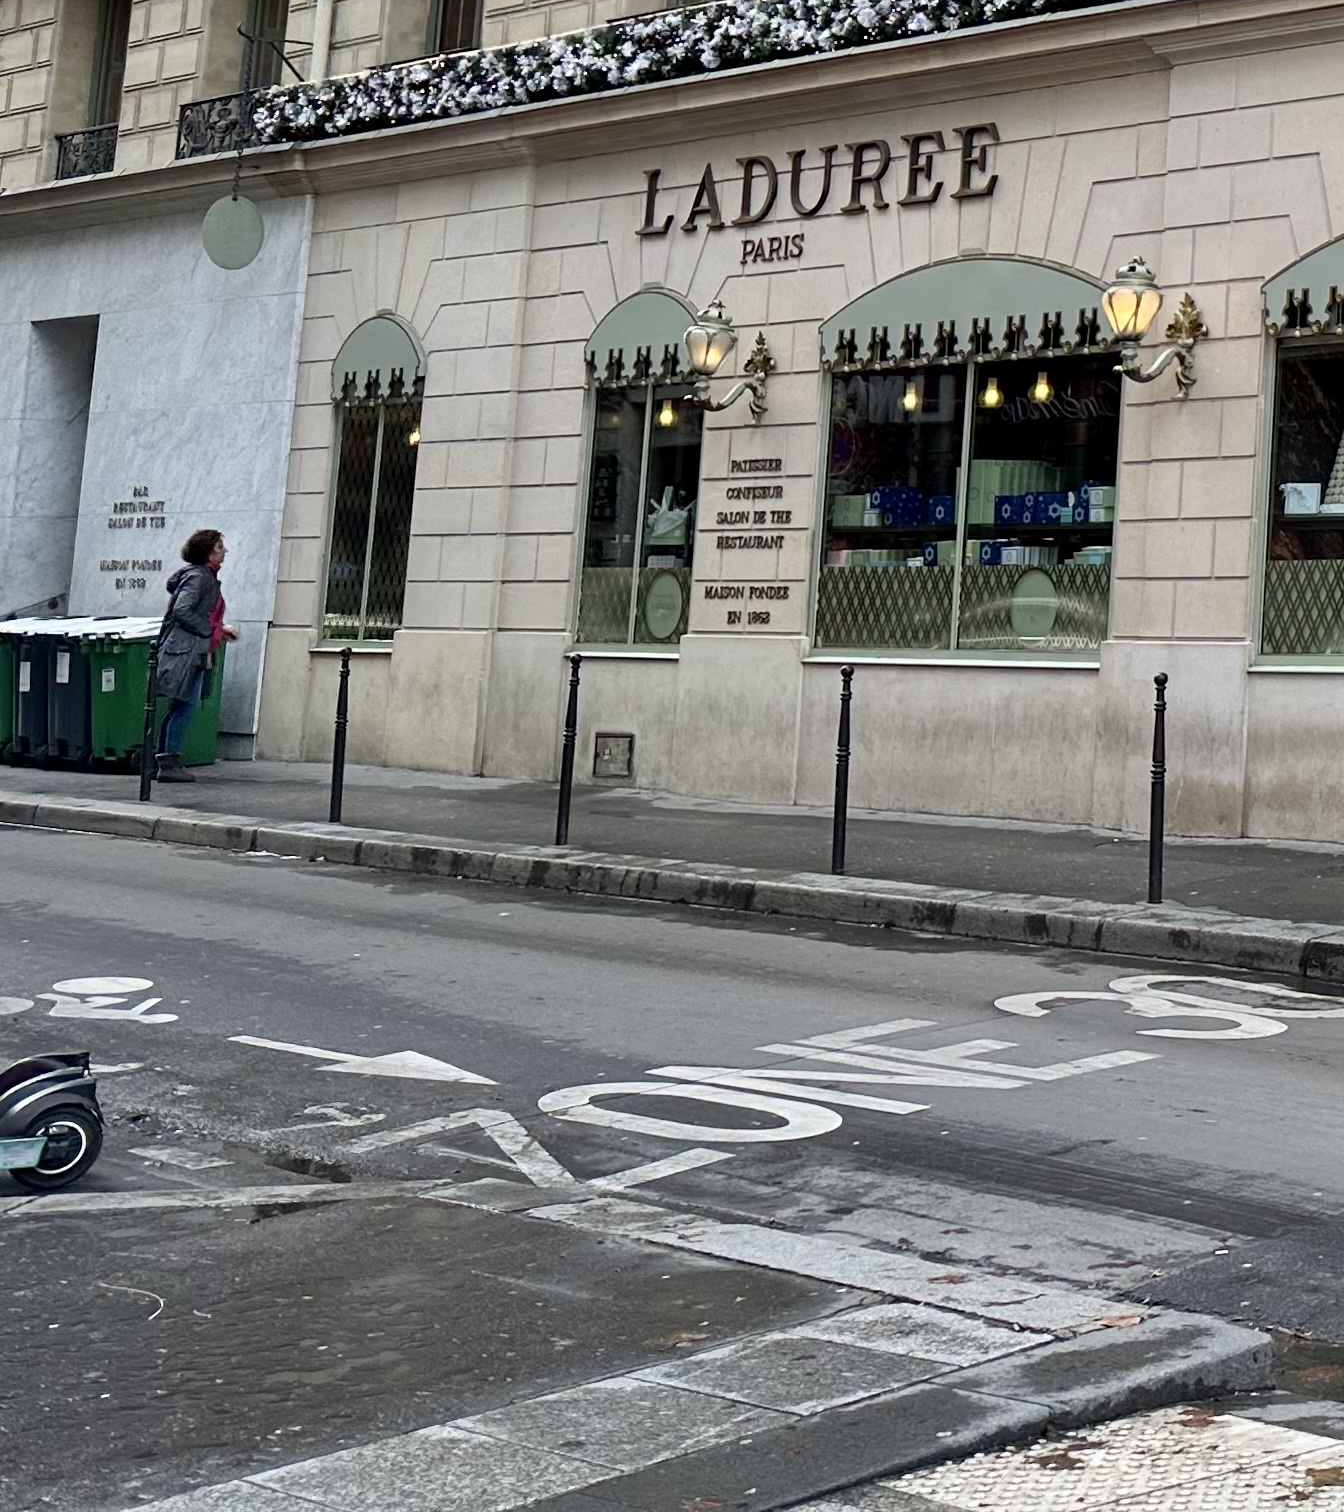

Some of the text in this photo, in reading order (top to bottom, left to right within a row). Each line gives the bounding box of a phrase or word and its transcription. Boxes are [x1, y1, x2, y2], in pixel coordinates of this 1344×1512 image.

[635, 122, 1000, 235] LADUREE
[740, 233, 805, 264] PARIS
[730, 458, 782, 473] PATISSIER
[726, 485, 783, 500] CONFISEUR
[716, 510, 792, 524] SALON DE THE
[716, 535, 784, 549] RESTAURANT
[704, 585, 789, 600] MAISON FONDEE
[727, 610, 770, 625] EN 1862
[336, 1018, 1162, 1191] ZONE
